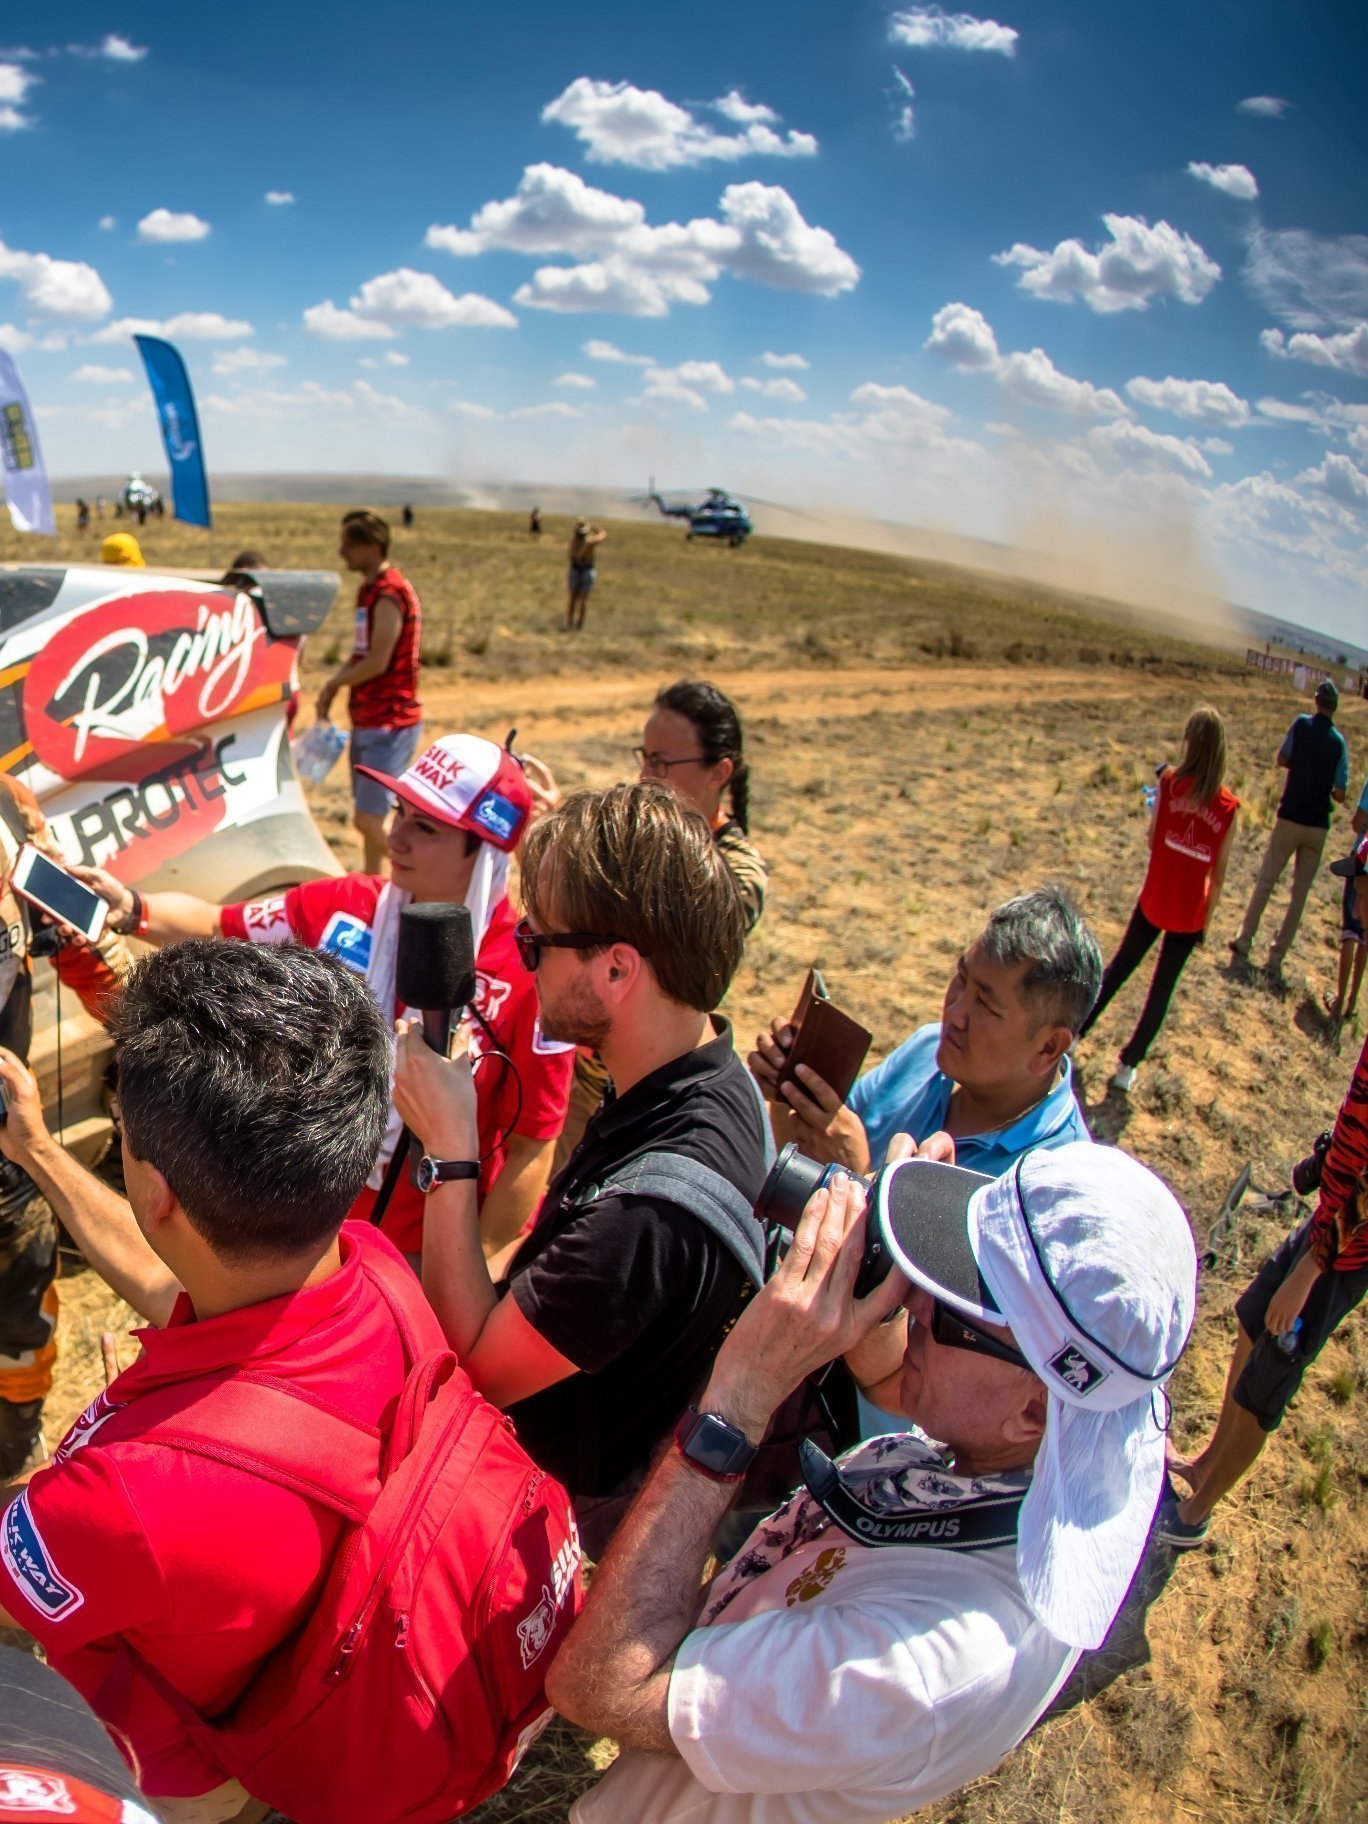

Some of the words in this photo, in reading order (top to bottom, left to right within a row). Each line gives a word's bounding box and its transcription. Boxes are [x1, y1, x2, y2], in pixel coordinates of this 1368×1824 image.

[54, 591, 267, 763] Racing
[50, 733, 247, 867] PROTEC
[415, 761, 453, 790] WAY
[855, 1516, 961, 1539] OLYMPUS
[19, 1546, 65, 1596] WAY
